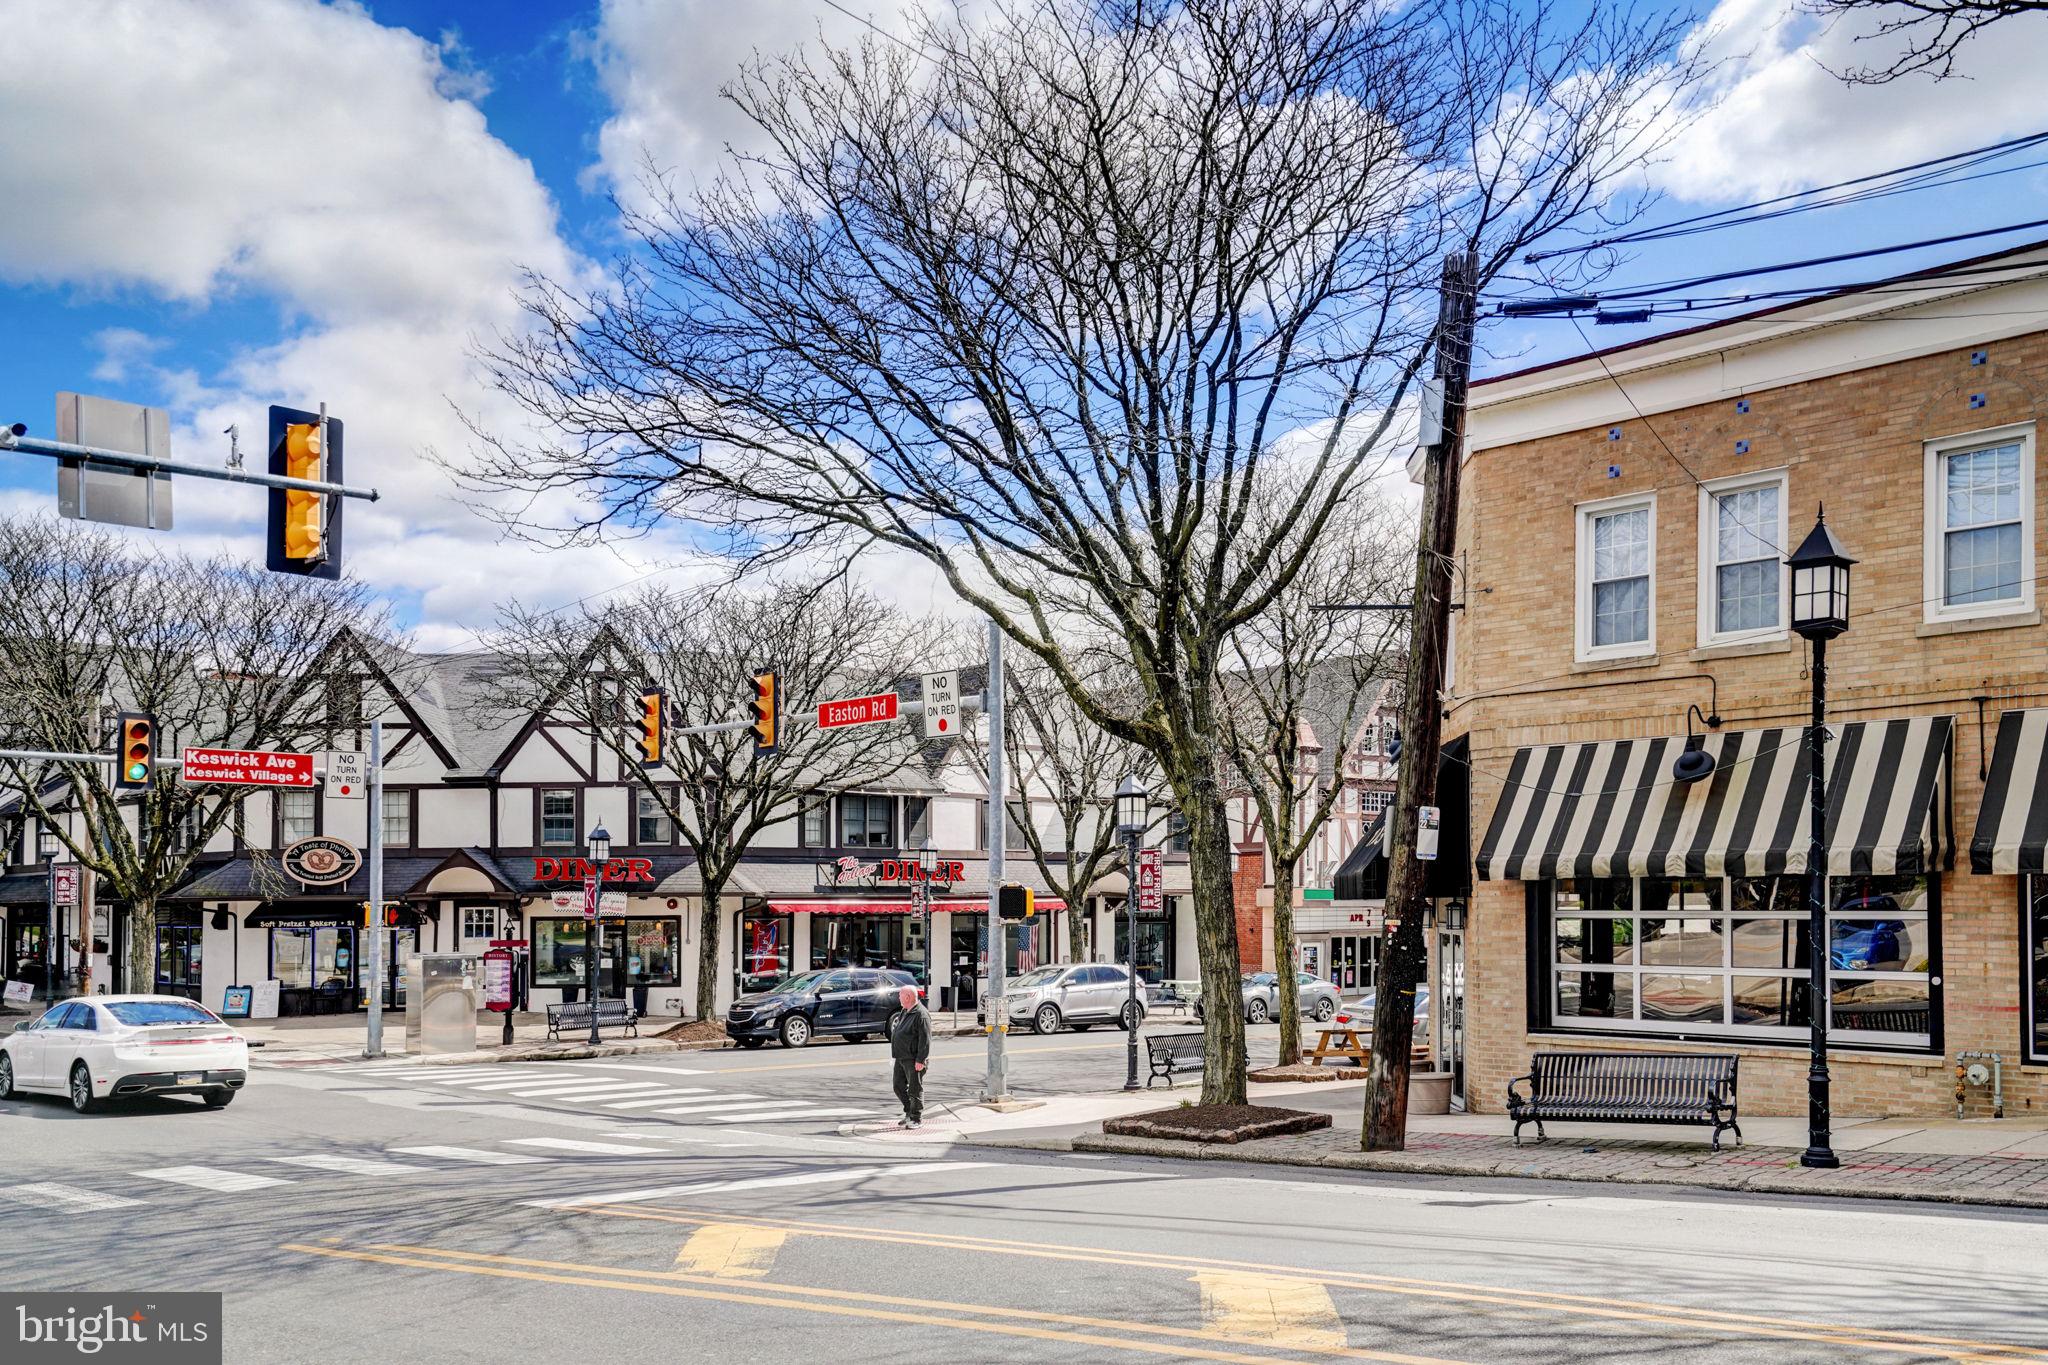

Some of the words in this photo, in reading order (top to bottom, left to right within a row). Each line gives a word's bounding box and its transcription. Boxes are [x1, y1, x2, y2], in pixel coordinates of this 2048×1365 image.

[932, 676, 947, 689] NO
[931, 692, 951, 703] TURN
[829, 704, 866, 723] Easton
[872, 699, 886, 717] Rd
[928, 706, 939, 717] ON
[941, 704, 956, 715] RED
[186, 750, 260, 767] Keswick
[265, 755, 296, 769] Ave
[339, 755, 355, 764] NO
[186, 766, 245, 780] Keswick
[249, 769, 294, 783] Village
[336, 765, 357, 774] TURN
[331, 775, 343, 783] ON
[345, 776, 361, 784] RED
[299, 842, 319, 852] Taste
[533, 857, 656, 882] DINER
[838, 856, 859, 871] The
[880, 859, 965, 882] DINER
[838, 864, 877, 883] Village
[585, 887, 595, 909] K
[1350, 914, 1363, 922] APR
[1367, 909, 1371, 917] 7
